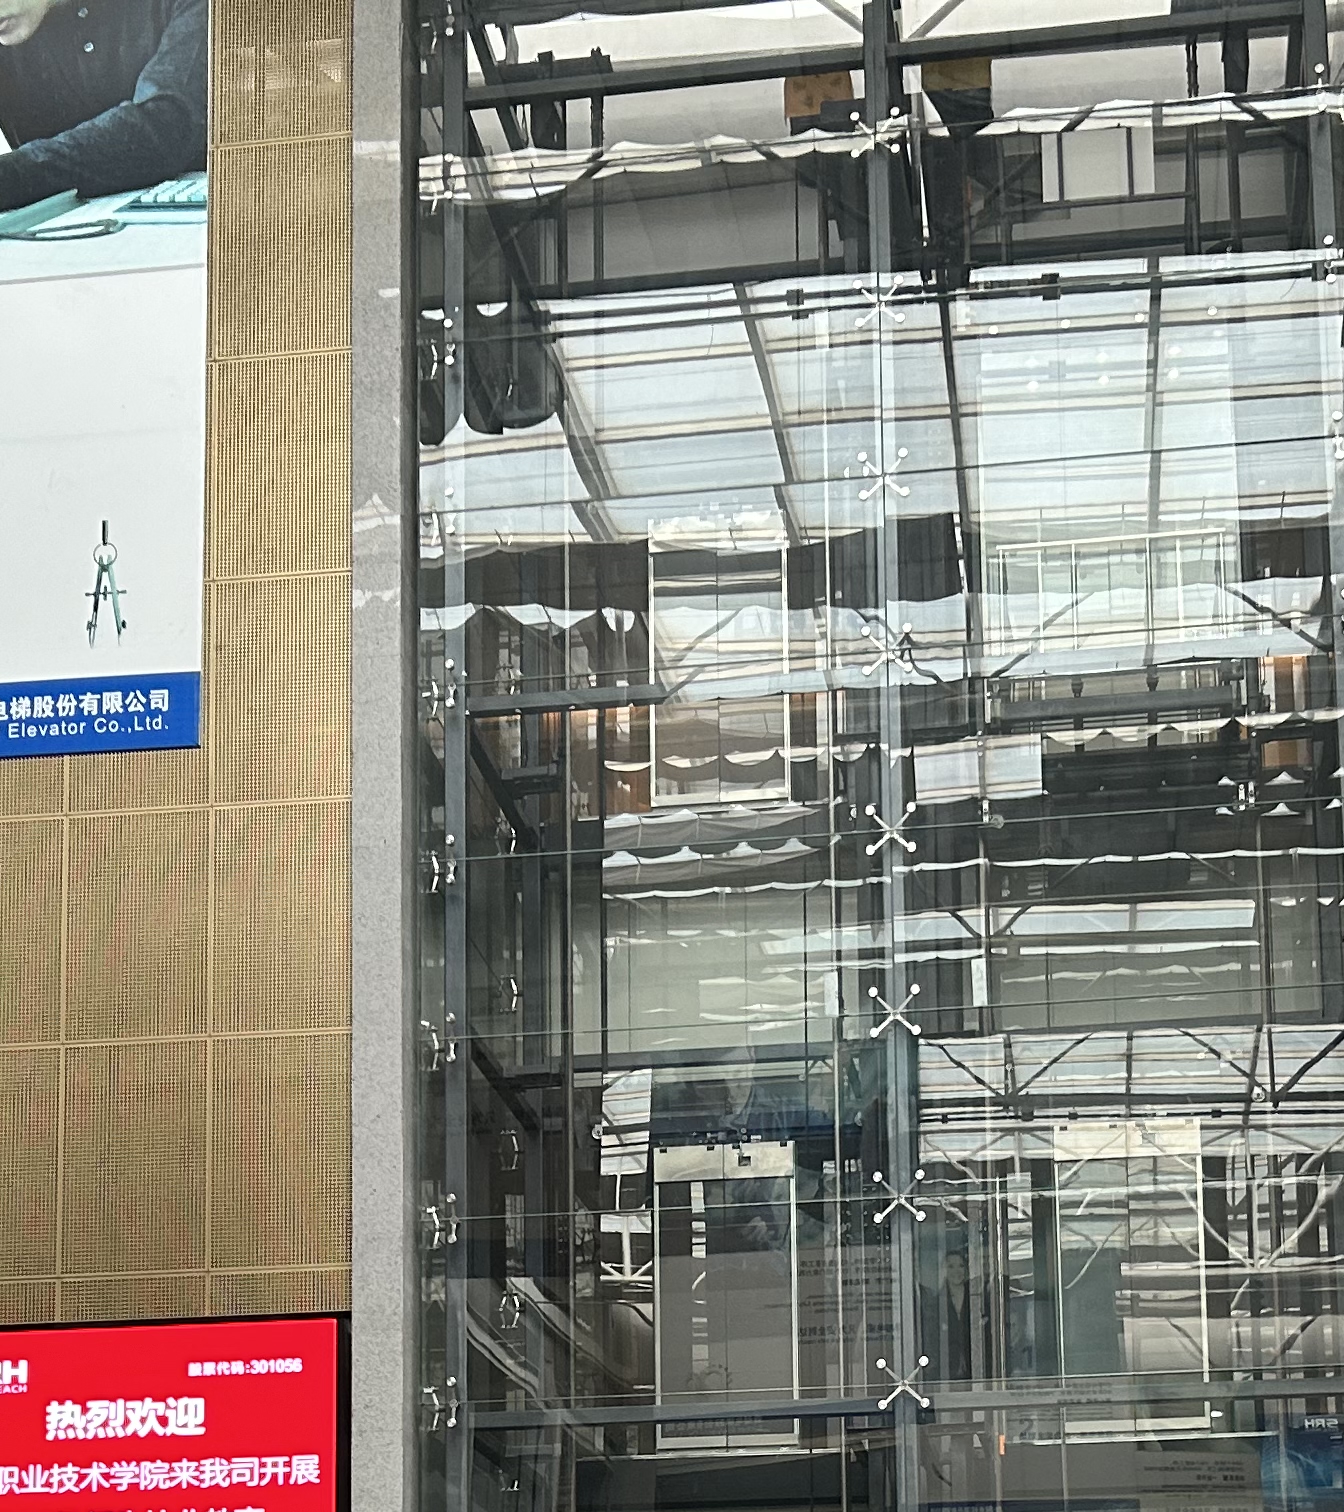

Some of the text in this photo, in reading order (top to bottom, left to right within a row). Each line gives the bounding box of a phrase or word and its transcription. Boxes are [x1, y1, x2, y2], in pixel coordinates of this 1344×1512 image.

[8, 720, 87, 739] Elevator
[93, 714, 169, 735] Co.,Ltd.
[45, 1396, 207, 1441] 热烈欢迎
